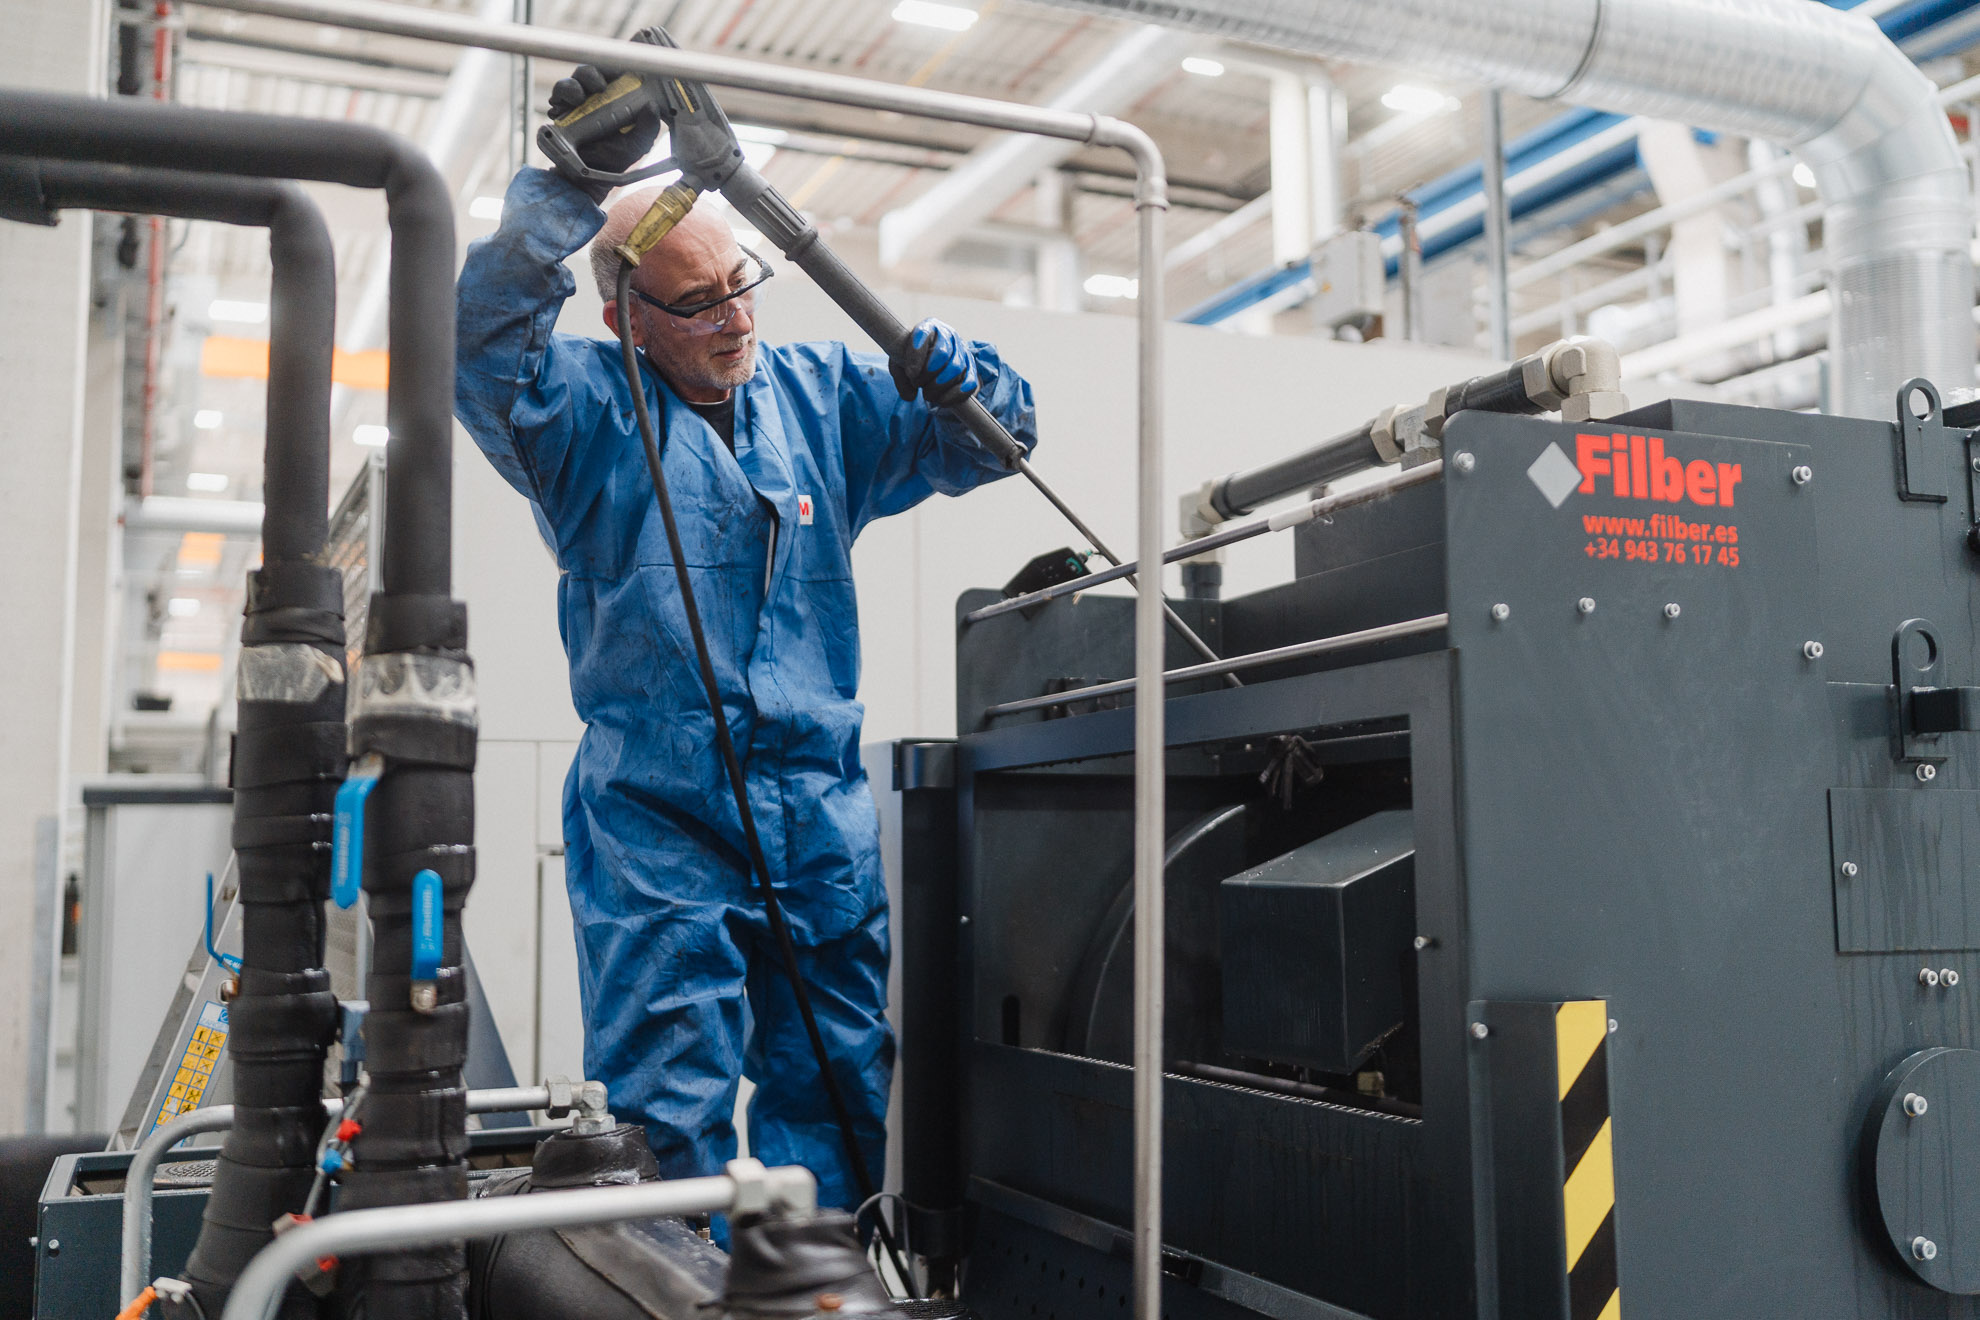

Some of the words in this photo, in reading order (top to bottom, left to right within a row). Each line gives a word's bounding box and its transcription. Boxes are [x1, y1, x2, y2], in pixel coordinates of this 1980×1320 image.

[1576, 433, 1742, 507] Filber
[1583, 513, 1738, 544] www.filber.es
[1584, 538, 1619, 559] +34
[1625, 540, 1658, 562] 943
[1664, 542, 1686, 563] 76
[1692, 545, 1712, 565] 17
[1717, 547, 1739, 567] 45
